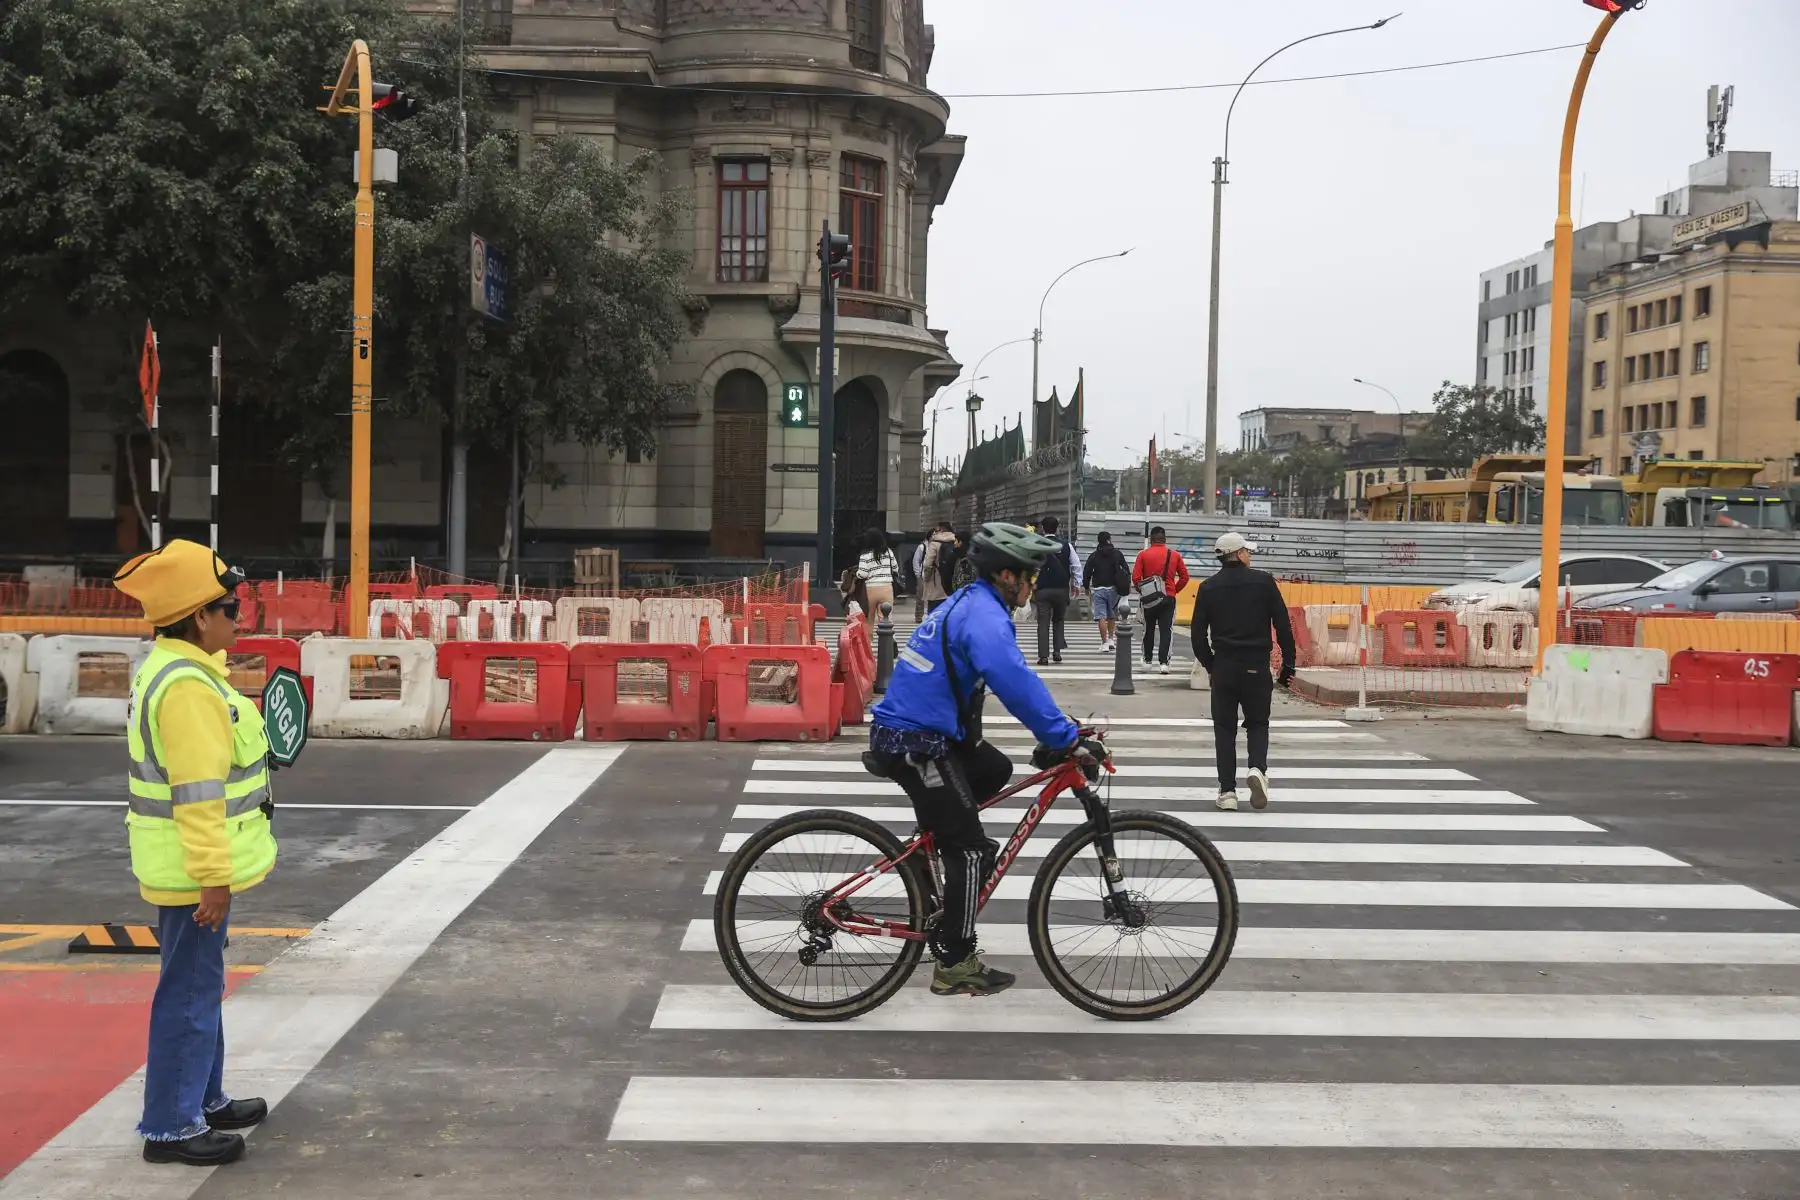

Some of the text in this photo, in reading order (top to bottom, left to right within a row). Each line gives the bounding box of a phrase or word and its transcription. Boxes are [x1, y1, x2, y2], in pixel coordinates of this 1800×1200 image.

[1676, 223, 1694, 237] CASA
[1695, 217, 1709, 231] DEL
[1710, 206, 1745, 225] MAESTRO
[488, 257, 508, 284] SOLO
[270, 684, 298, 752] SIGA
[985, 803, 1040, 891] MOSSO
